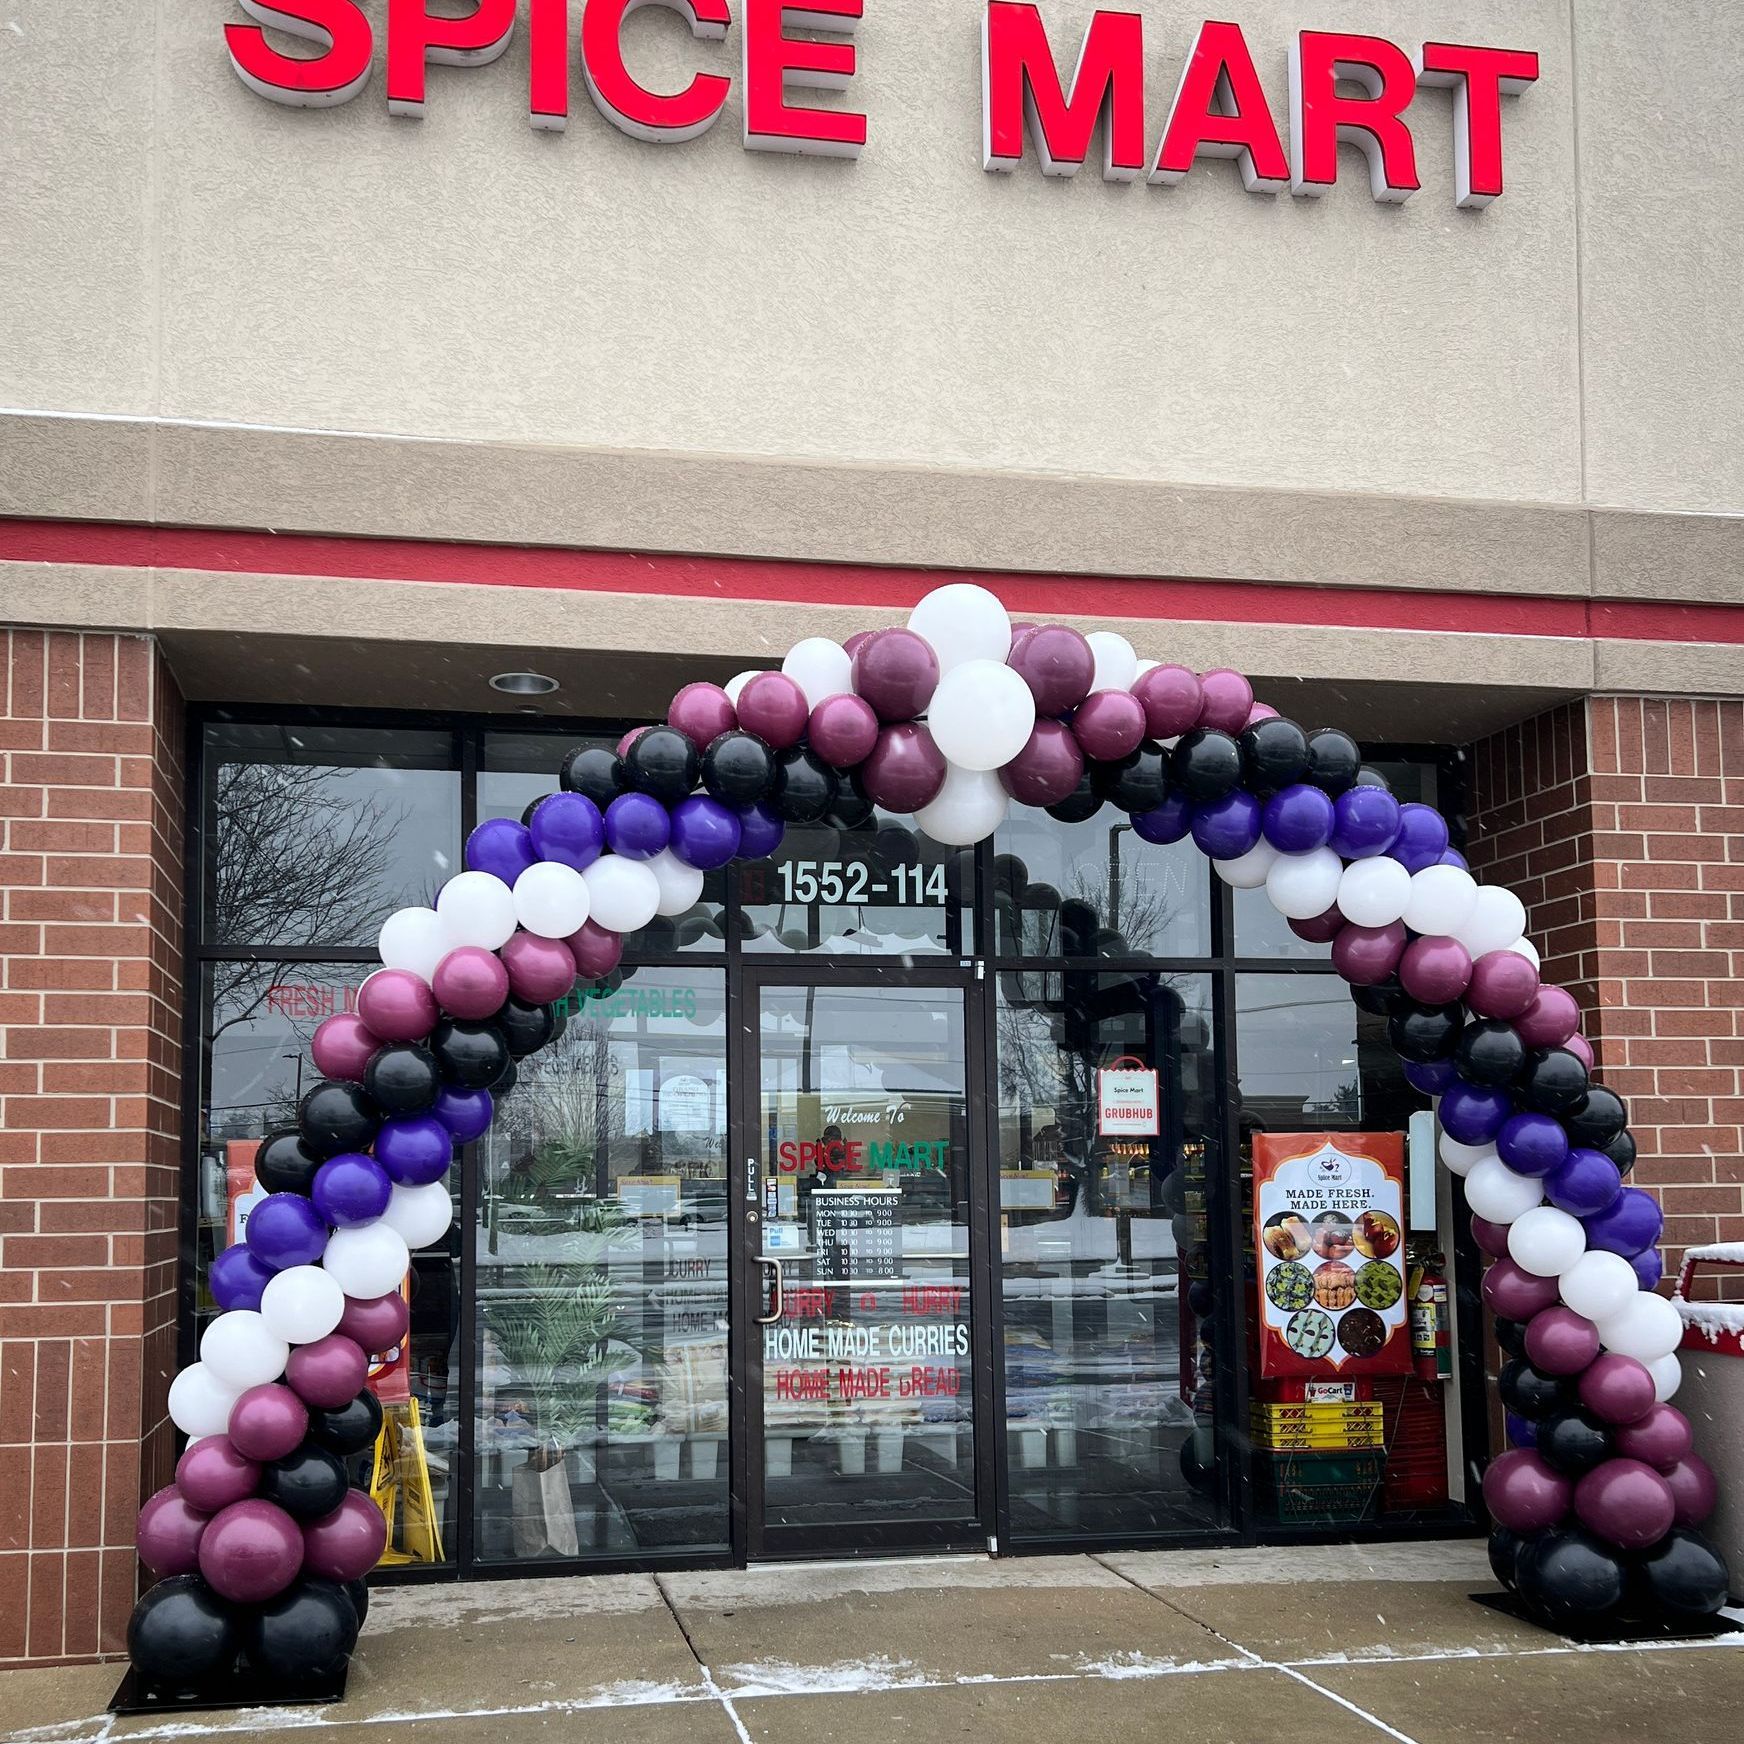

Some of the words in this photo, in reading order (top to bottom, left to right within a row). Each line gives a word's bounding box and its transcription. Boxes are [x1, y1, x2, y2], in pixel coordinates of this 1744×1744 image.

[224, 0, 866, 150] SPICE
[983, 0, 1539, 203] MART
[777, 860, 949, 904] 1552-114
[1074, 862, 1188, 899] OPEN
[267, 985, 335, 1017] FRESH
[576, 987, 697, 1019] VEGETABLES
[825, 1105, 881, 1125] Welcome
[886, 1101, 912, 1125] To
[1105, 1108, 1153, 1118] GRUBHUB
[779, 1140, 864, 1172] SPICE
[868, 1140, 950, 1171] MART
[747, 1158, 755, 1191] PULL
[815, 1196, 860, 1206] BUSINESS
[863, 1196, 898, 1206] HOURS
[1286, 1189, 1323, 1198] MADE
[1328, 1188, 1375, 1198] FRESH.
[1291, 1200, 1327, 1209] MADE
[1332, 1200, 1371, 1209] HERE.
[816, 1219, 832, 1227] TUE
[816, 1248, 829, 1256] FRI
[816, 1267, 834, 1275] SUN
[902, 1285, 961, 1316] HURRY
[765, 1327, 820, 1359] HOME
[828, 1326, 880, 1358] MADE
[888, 1324, 969, 1357] CURRIES
[776, 1368, 831, 1400] HOME
[839, 1366, 891, 1397] MADE
[1317, 1386, 1343, 1395] GoCart
